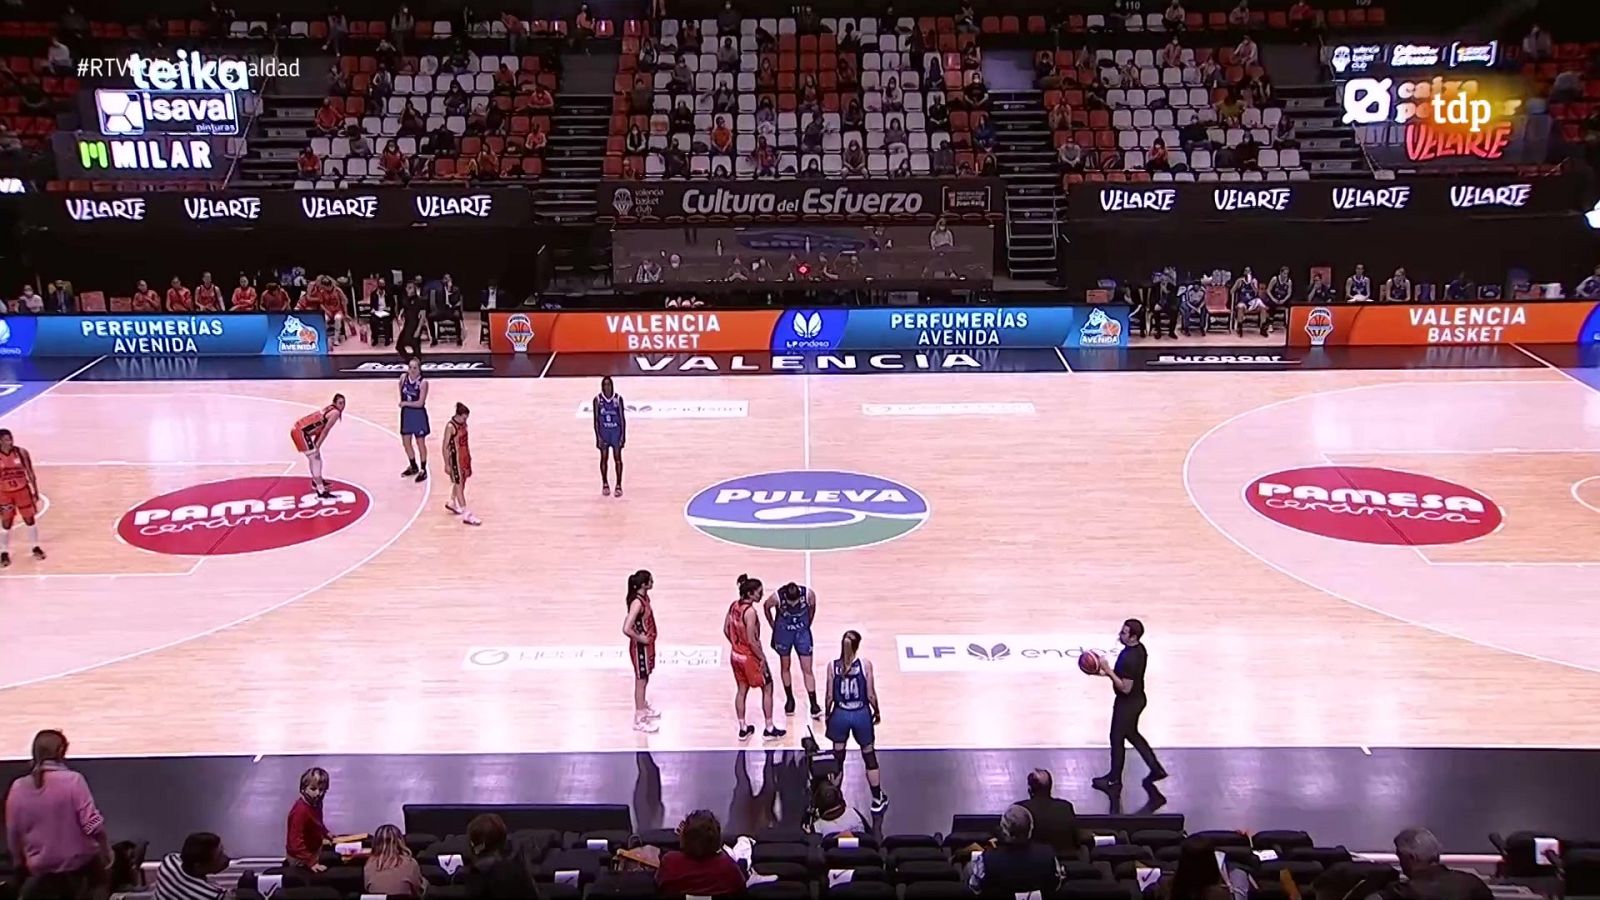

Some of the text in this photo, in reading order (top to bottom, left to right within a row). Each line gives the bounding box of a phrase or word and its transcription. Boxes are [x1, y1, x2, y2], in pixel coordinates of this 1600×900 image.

[130, 49, 249, 90] teika
[144, 93, 235, 121] isaval
[111, 140, 212, 169] MILAR
[302, 195, 378, 218] VELARTE
[416, 194, 492, 217] VELARTE
[682, 188, 923, 214] Cultura del Esfuerzo
[1100, 189, 1176, 211] VELARTE
[1214, 188, 1291, 210] VELARTE
[1332, 186, 1411, 210] VELARTE
[1450, 184, 1532, 208] VELARTE
[65, 198, 146, 221] VELARTE
[184, 197, 261, 220] VELARTE
[81, 315, 224, 336] PERFUMERÍAS
[606, 313, 720, 333] VALENCIA
[891, 307, 1028, 329] PERFUMERÍAS
[1409, 306, 1527, 327] VALENCIA
[113, 336, 197, 354] AVENIDA
[628, 333, 699, 350] BASKET
[918, 329, 1000, 346] AVENIDA
[1427, 326, 1504, 343] BASKET
[635, 353, 983, 370] VALENCIA
[715, 488, 908, 504] PULEVA
[1258, 482, 1485, 513] PAMESA
[133, 490, 357, 526] PAMESA
[905, 646, 956, 659] LF
[840, 677, 860, 700] 44
